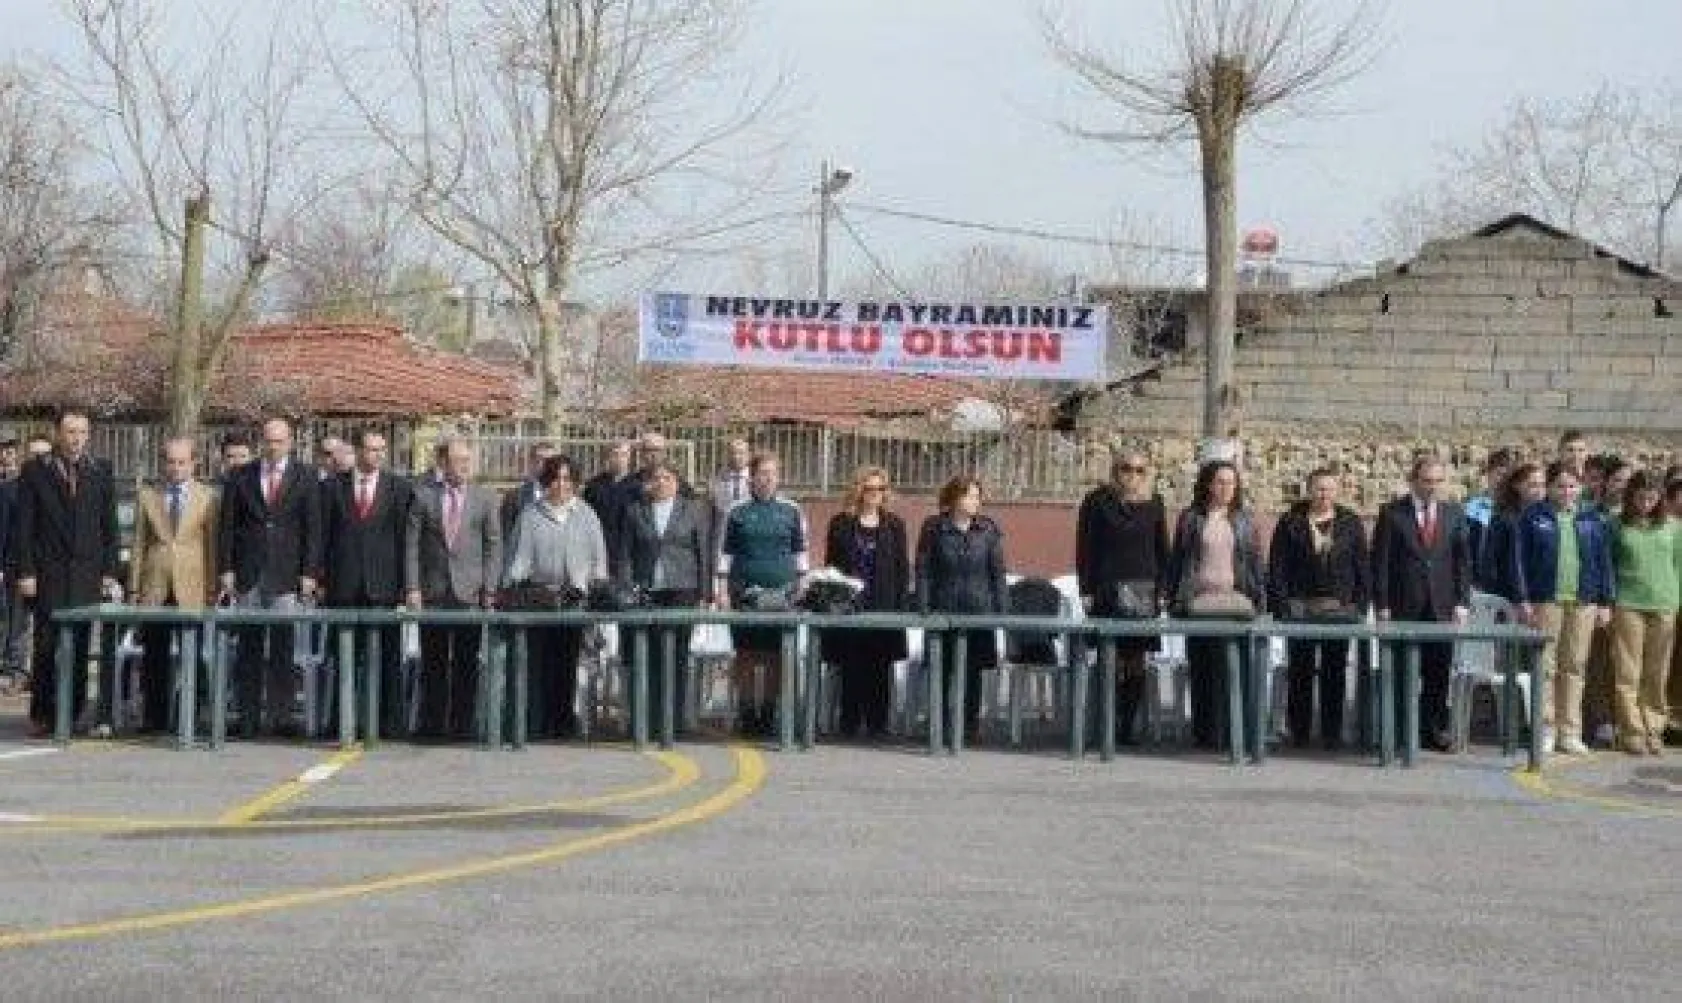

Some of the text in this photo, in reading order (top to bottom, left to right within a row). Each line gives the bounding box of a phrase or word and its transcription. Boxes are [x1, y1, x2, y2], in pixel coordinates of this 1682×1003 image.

[706, 296, 1094, 329] NEVRUZ BAYRAMINIZ
[734, 320, 881, 355] KUTLU
[903, 329, 1062, 363] OLSUN
